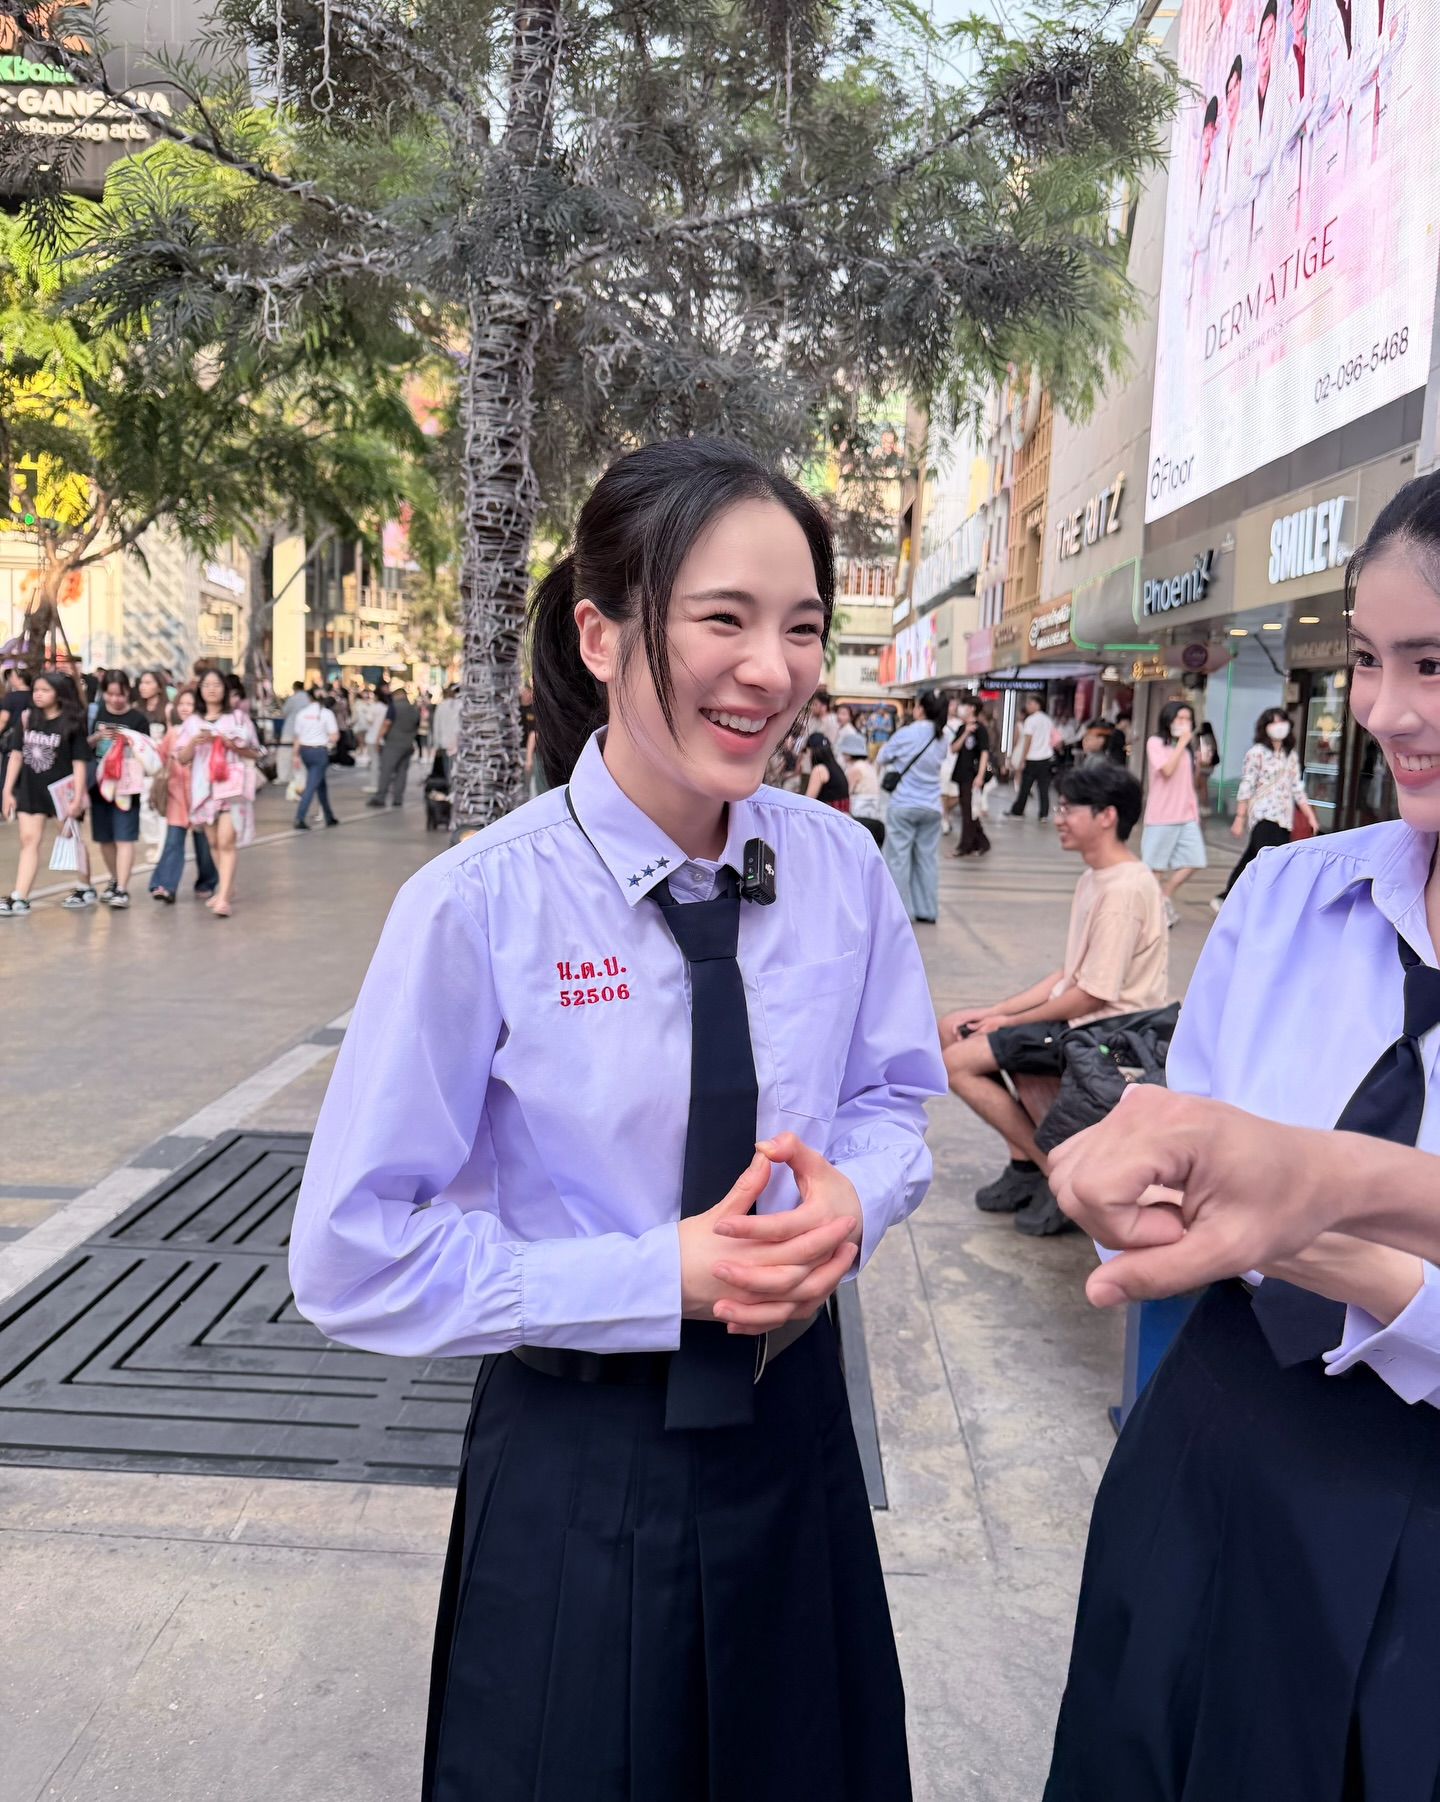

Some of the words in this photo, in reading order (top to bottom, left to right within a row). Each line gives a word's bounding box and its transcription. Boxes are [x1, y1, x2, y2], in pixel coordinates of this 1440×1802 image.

[110, 120, 150, 140] arts
[1203, 216, 1338, 360] DERMATIGE
[1314, 326, 1410, 403] 02-096-5468
[1056, 507, 1083, 561] THE
[1269, 495, 1345, 585] SMILEY
[560, 983, 630, 1007] 52506
